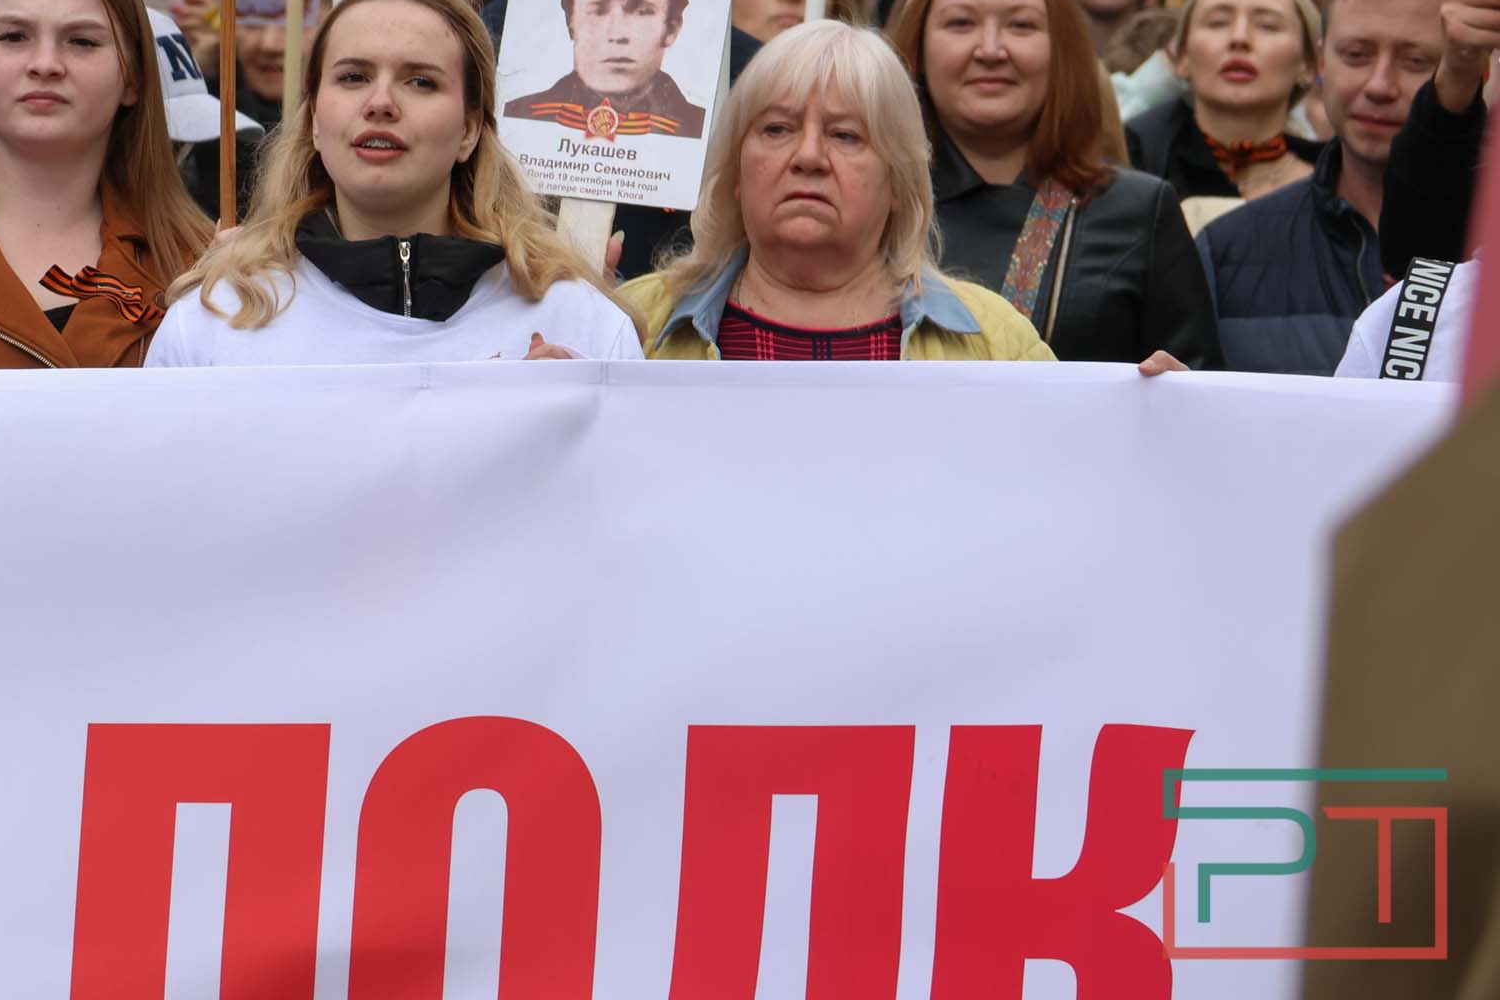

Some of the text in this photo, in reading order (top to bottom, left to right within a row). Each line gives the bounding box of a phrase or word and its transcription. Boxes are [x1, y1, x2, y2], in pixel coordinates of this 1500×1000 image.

[557, 137, 638, 161] Лукашев
[519, 153, 672, 181] Владимир Семенович
[527, 168, 659, 192] Погиб 19 сентября 1944 года
[580, 187, 613, 197] смерти
[1399, 259, 1452, 322] NICE
[68, 714, 1197, 1000] ПОЛК
